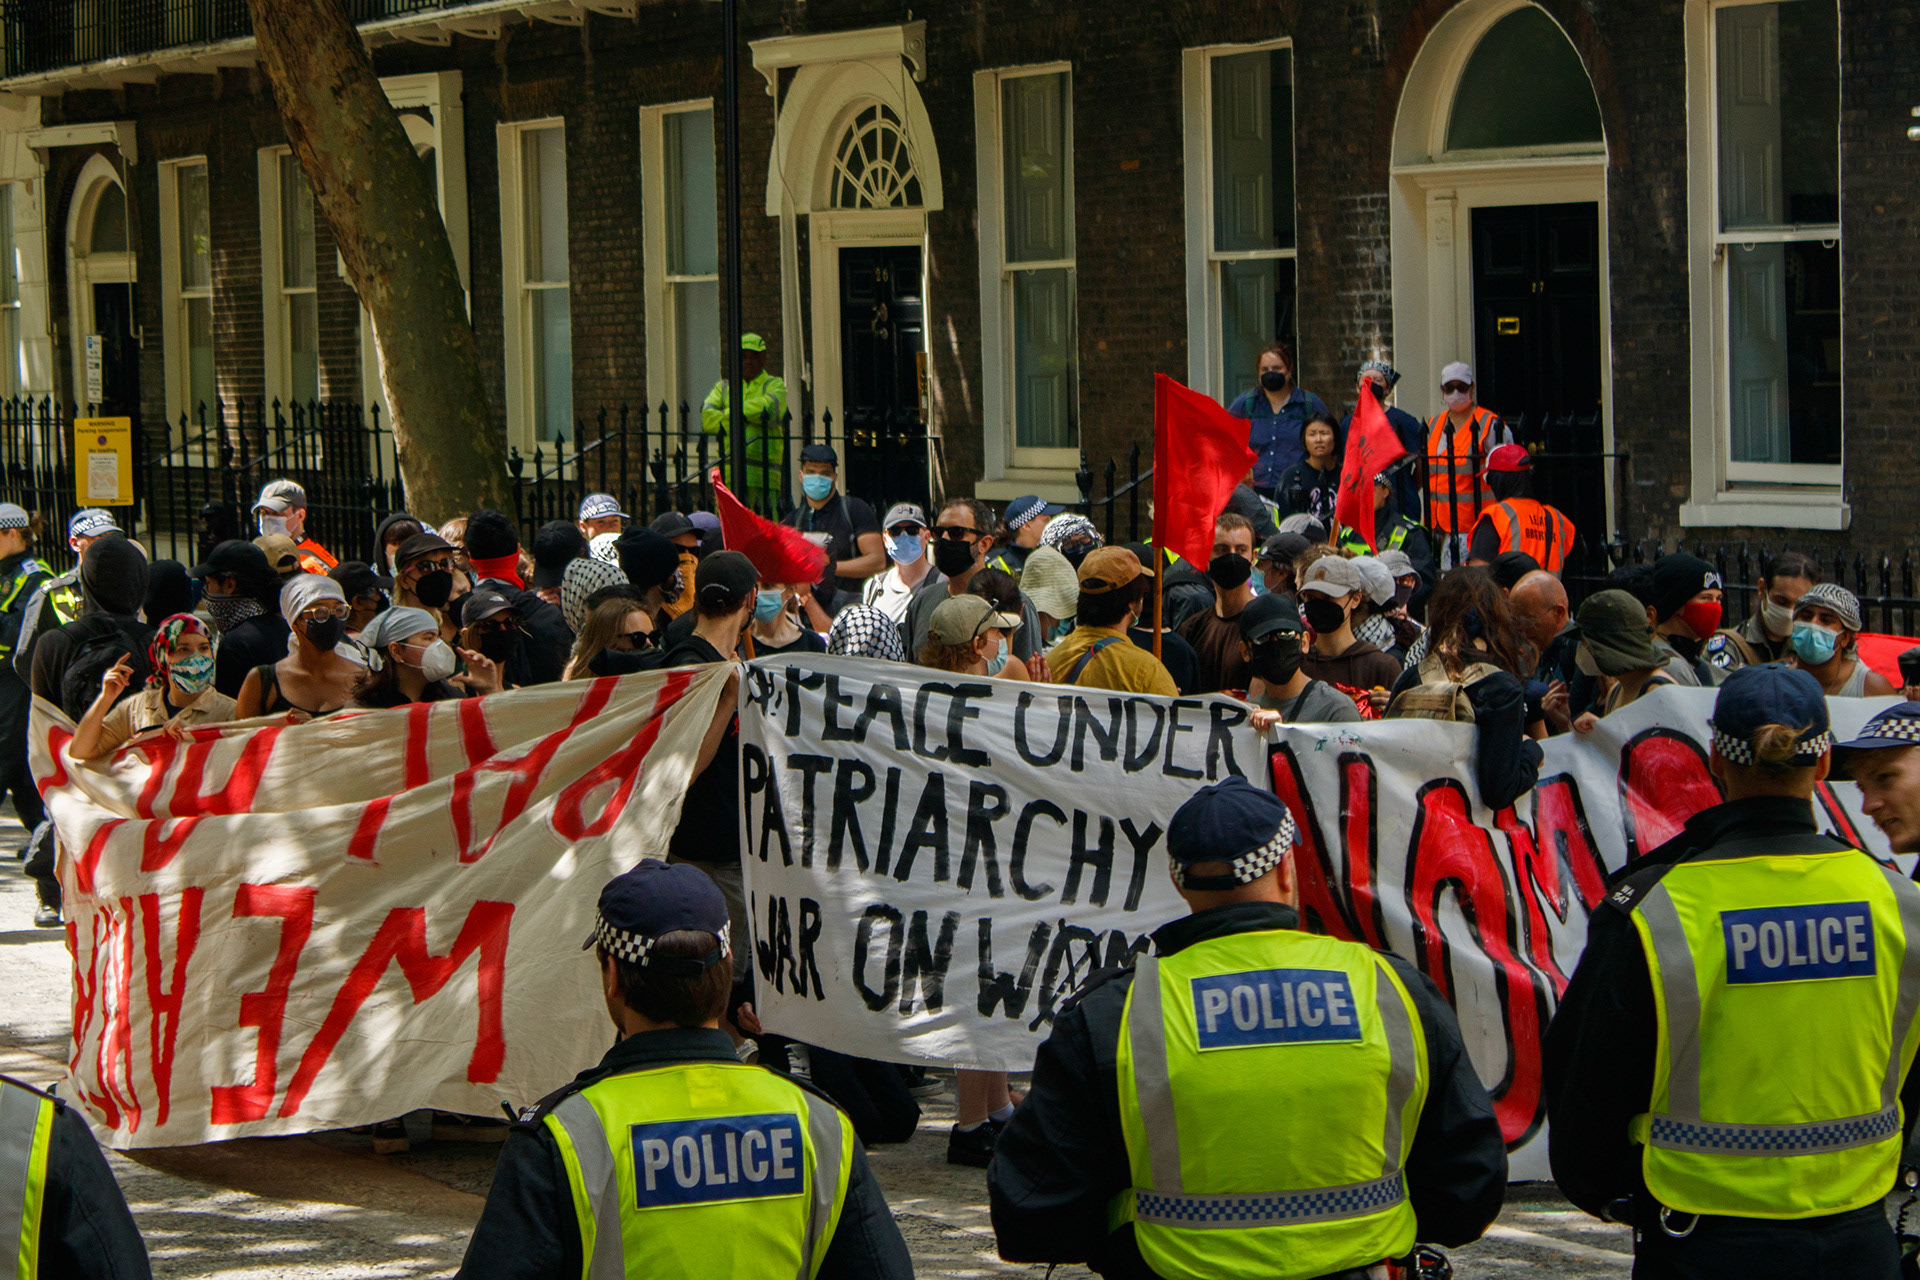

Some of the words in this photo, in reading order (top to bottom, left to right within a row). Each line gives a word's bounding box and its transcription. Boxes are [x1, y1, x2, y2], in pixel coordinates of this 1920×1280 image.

[784, 665, 992, 767] PEACE
[1014, 691, 1250, 782] UNDER
[743, 743, 1164, 912] PATRIARCHY
[751, 889, 826, 1002] WAR
[853, 904, 961, 1015] ON
[1731, 915, 1869, 970] POLICE
[211, 882, 516, 1127] WE
[1202, 981, 1352, 1034] POLICE
[641, 1128, 796, 1191] POLICE
